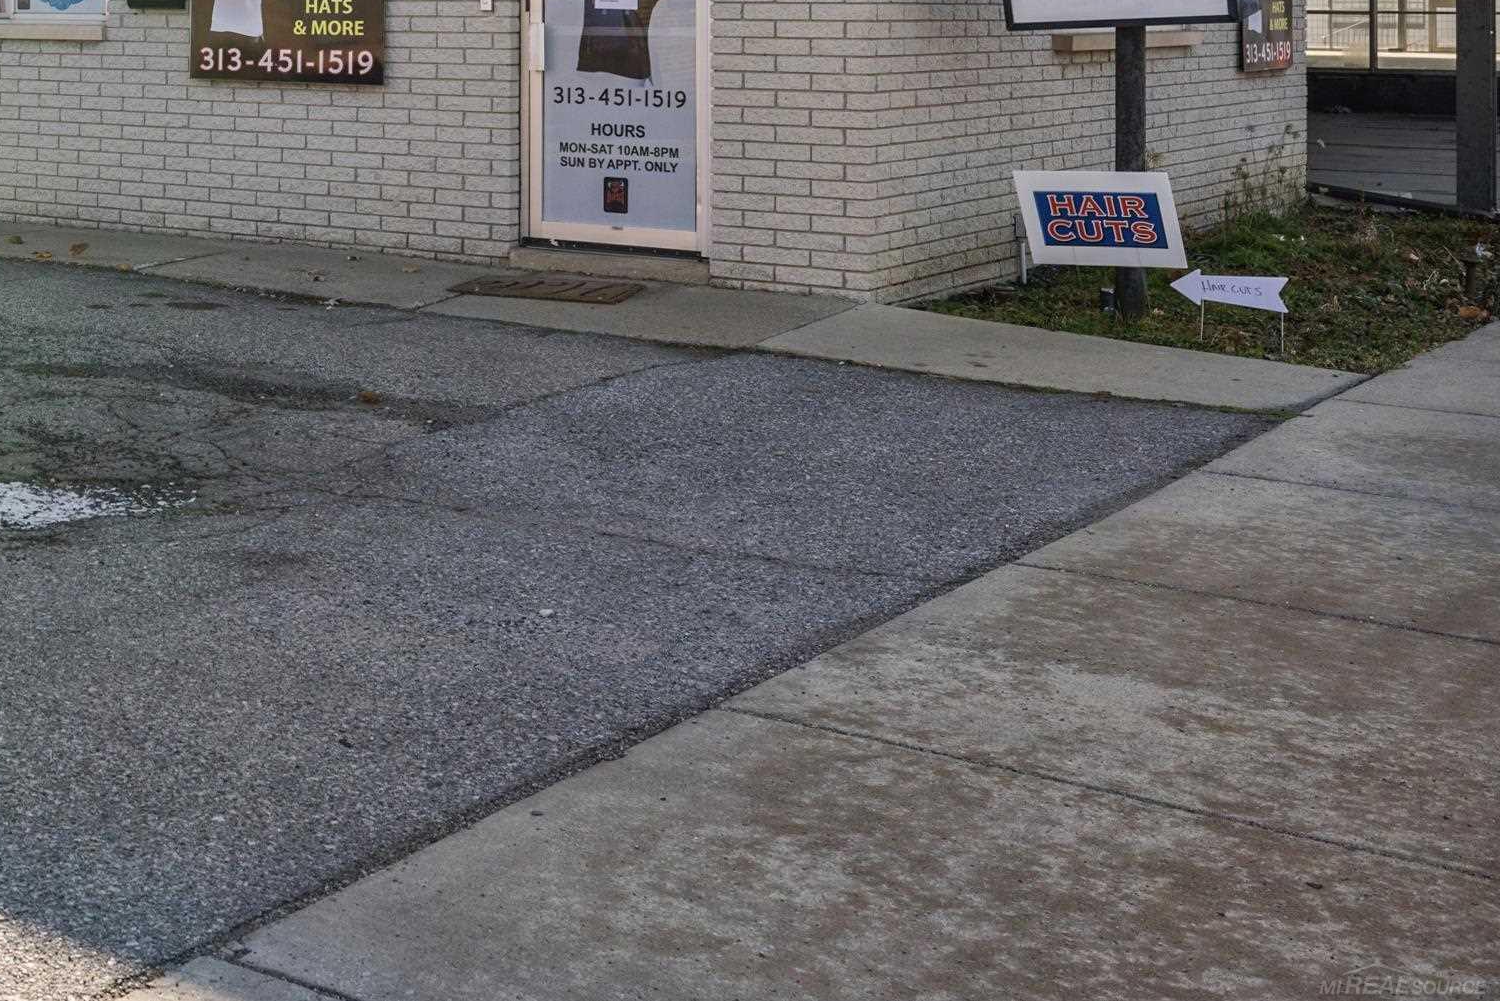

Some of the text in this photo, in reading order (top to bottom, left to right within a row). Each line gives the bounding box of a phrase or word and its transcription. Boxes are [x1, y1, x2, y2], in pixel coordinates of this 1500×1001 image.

[293, 20, 365, 36] & MORE
[200, 47, 374, 75] 313-451-1519
[553, 86, 687, 108] 313-451-1519
[591, 123, 646, 138] HOURS
[559, 142, 679, 159] MON-SAT 10AM-8PM
[560, 156, 678, 173] SUN BY APPT. ONLY
[1047, 193, 1149, 219] HAIR
[1047, 219, 1157, 244] CUTS
